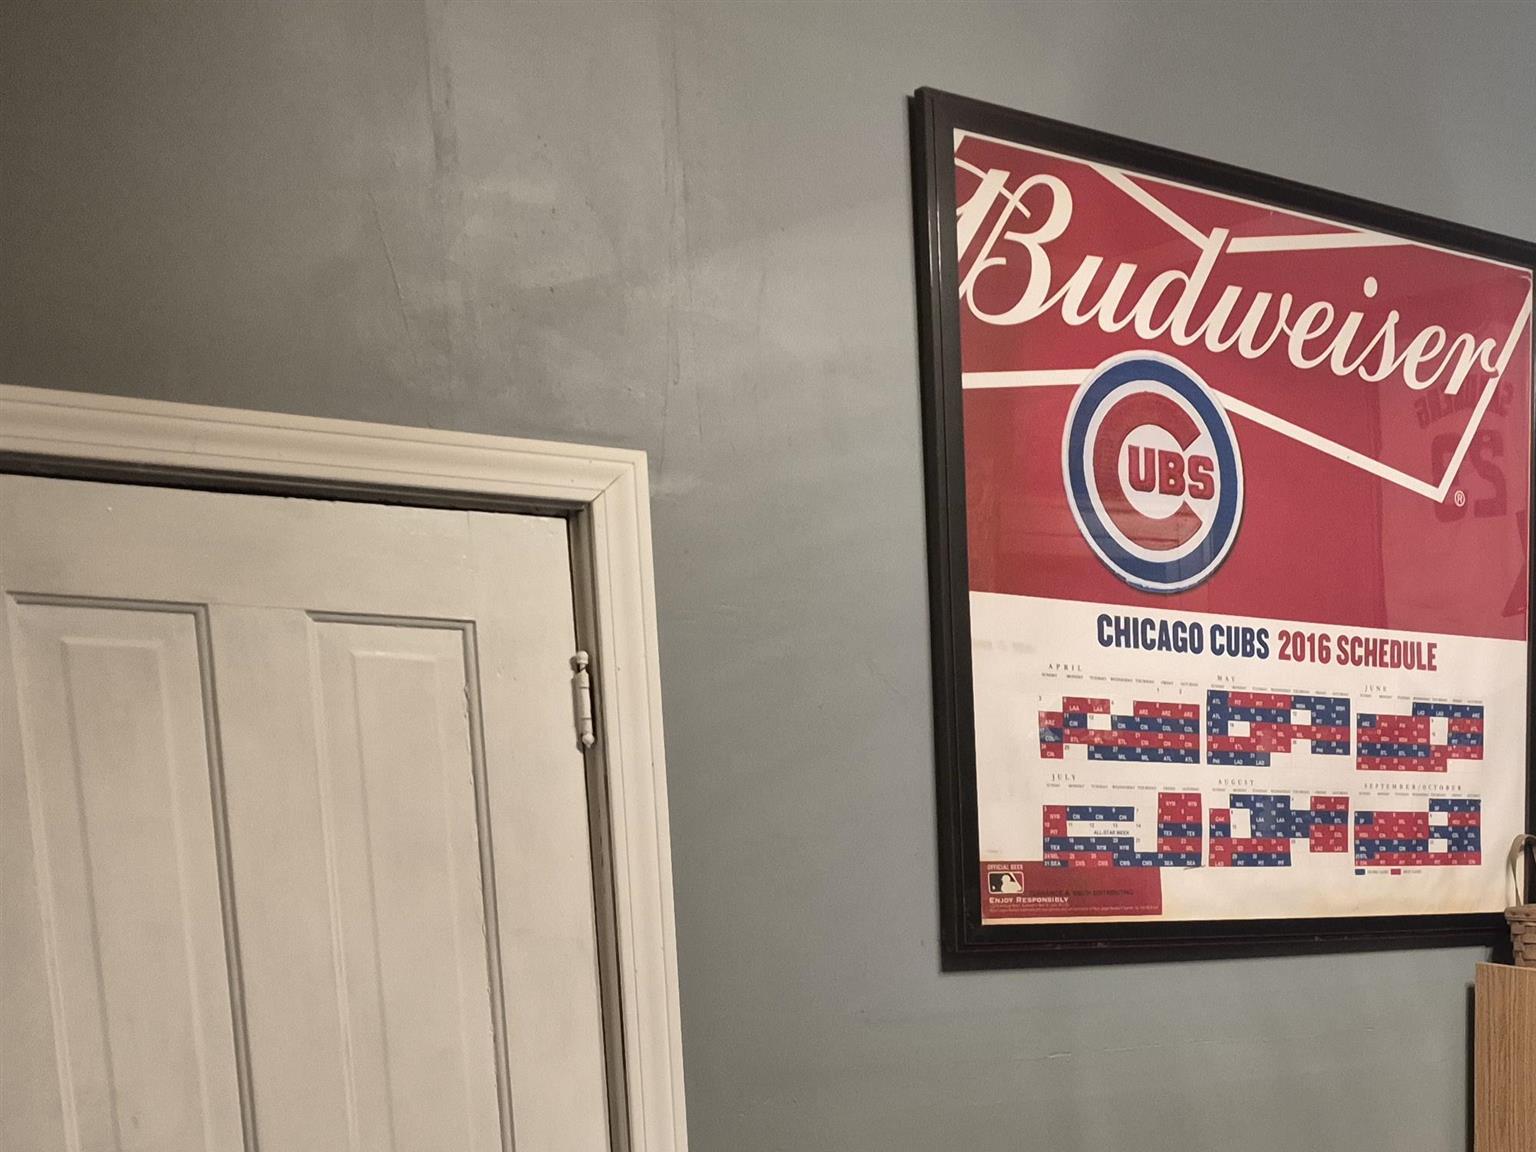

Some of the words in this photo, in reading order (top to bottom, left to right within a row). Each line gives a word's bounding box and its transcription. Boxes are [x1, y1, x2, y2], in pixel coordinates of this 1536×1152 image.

[954, 168, 1501, 396] Budweiser
[1096, 613, 1205, 655] CHICAGO
[1209, 623, 1270, 660] CUBS
[1277, 629, 1332, 665] 2016
[1336, 634, 1438, 672] SCHEDULE
[1048, 663, 1082, 671] APRIL
[1052, 773, 1076, 781] JULY
[989, 896, 1013, 904] ENJOY
[1016, 896, 1068, 904] RESPONSIBLY
